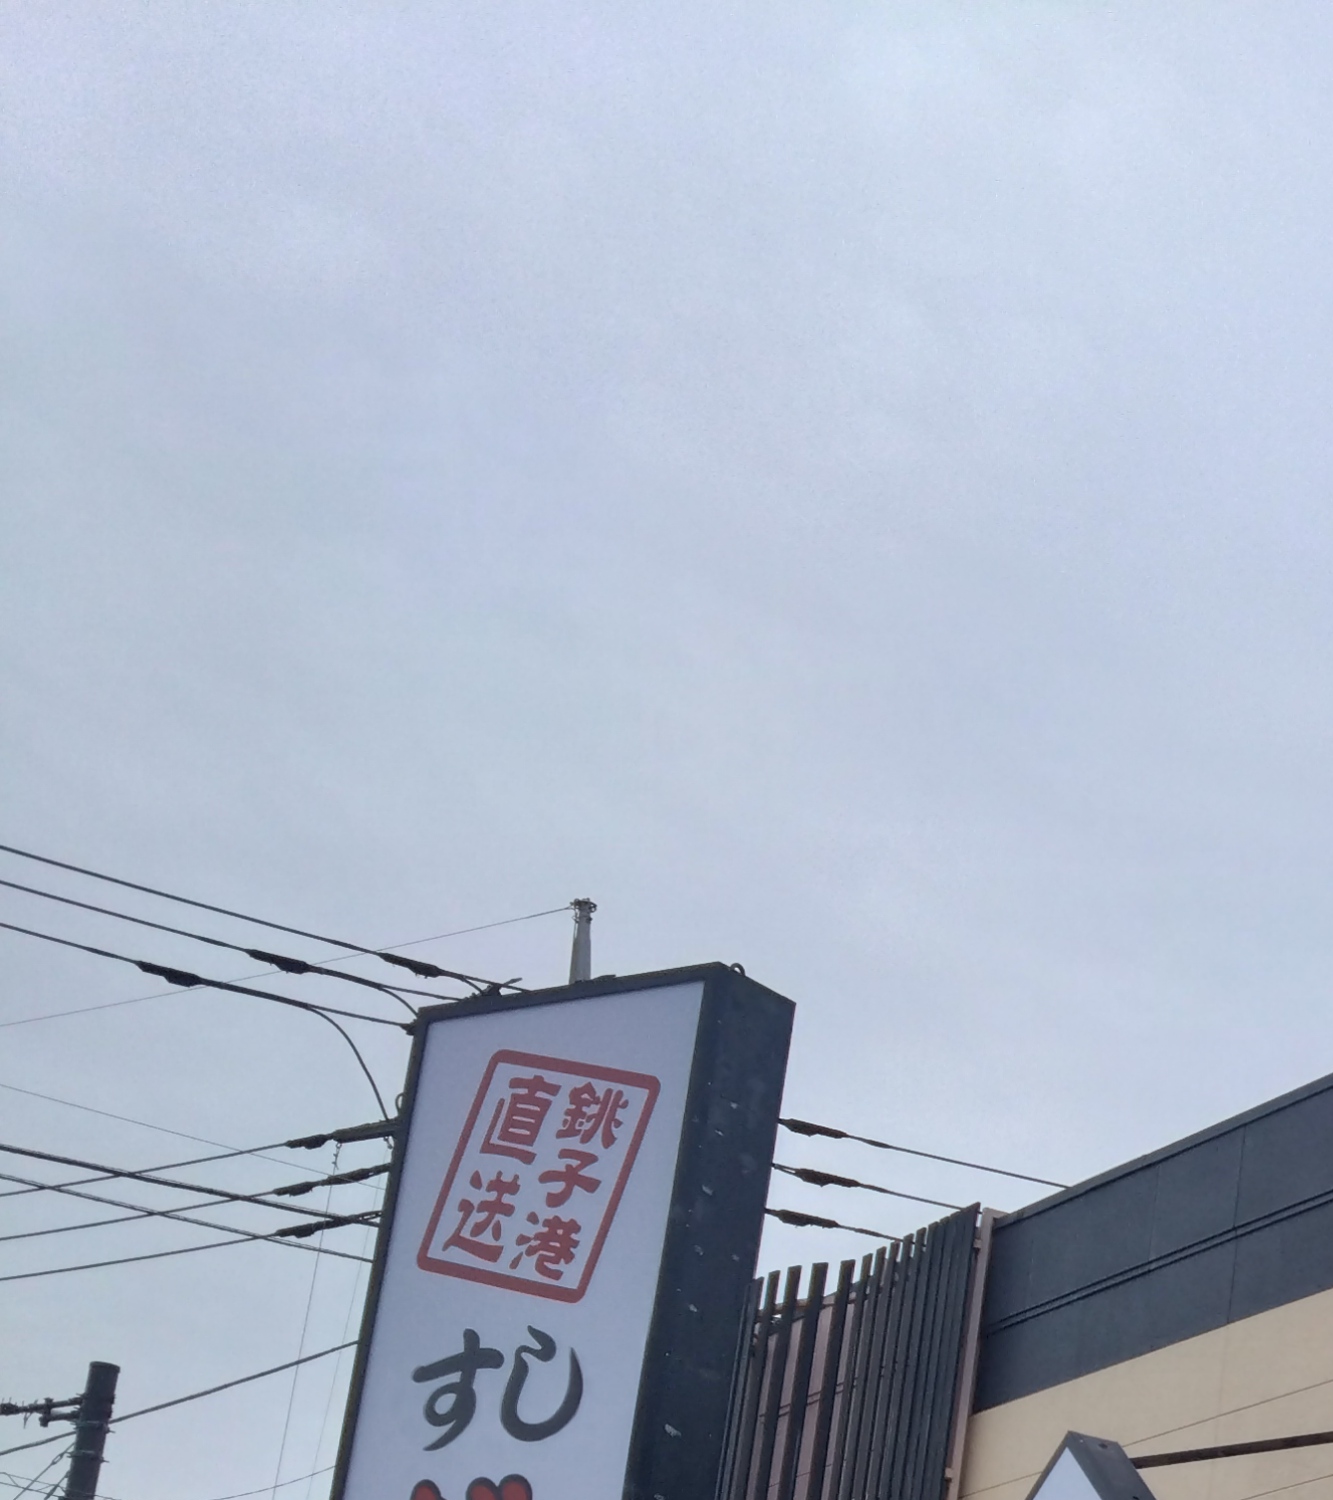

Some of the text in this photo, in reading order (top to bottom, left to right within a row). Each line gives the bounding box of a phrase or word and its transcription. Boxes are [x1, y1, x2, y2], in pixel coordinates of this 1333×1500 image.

[442, 1075, 561, 1263] 直送
[509, 1080, 629, 1281] 銚子港
[412, 1325, 584, 1451] すし
